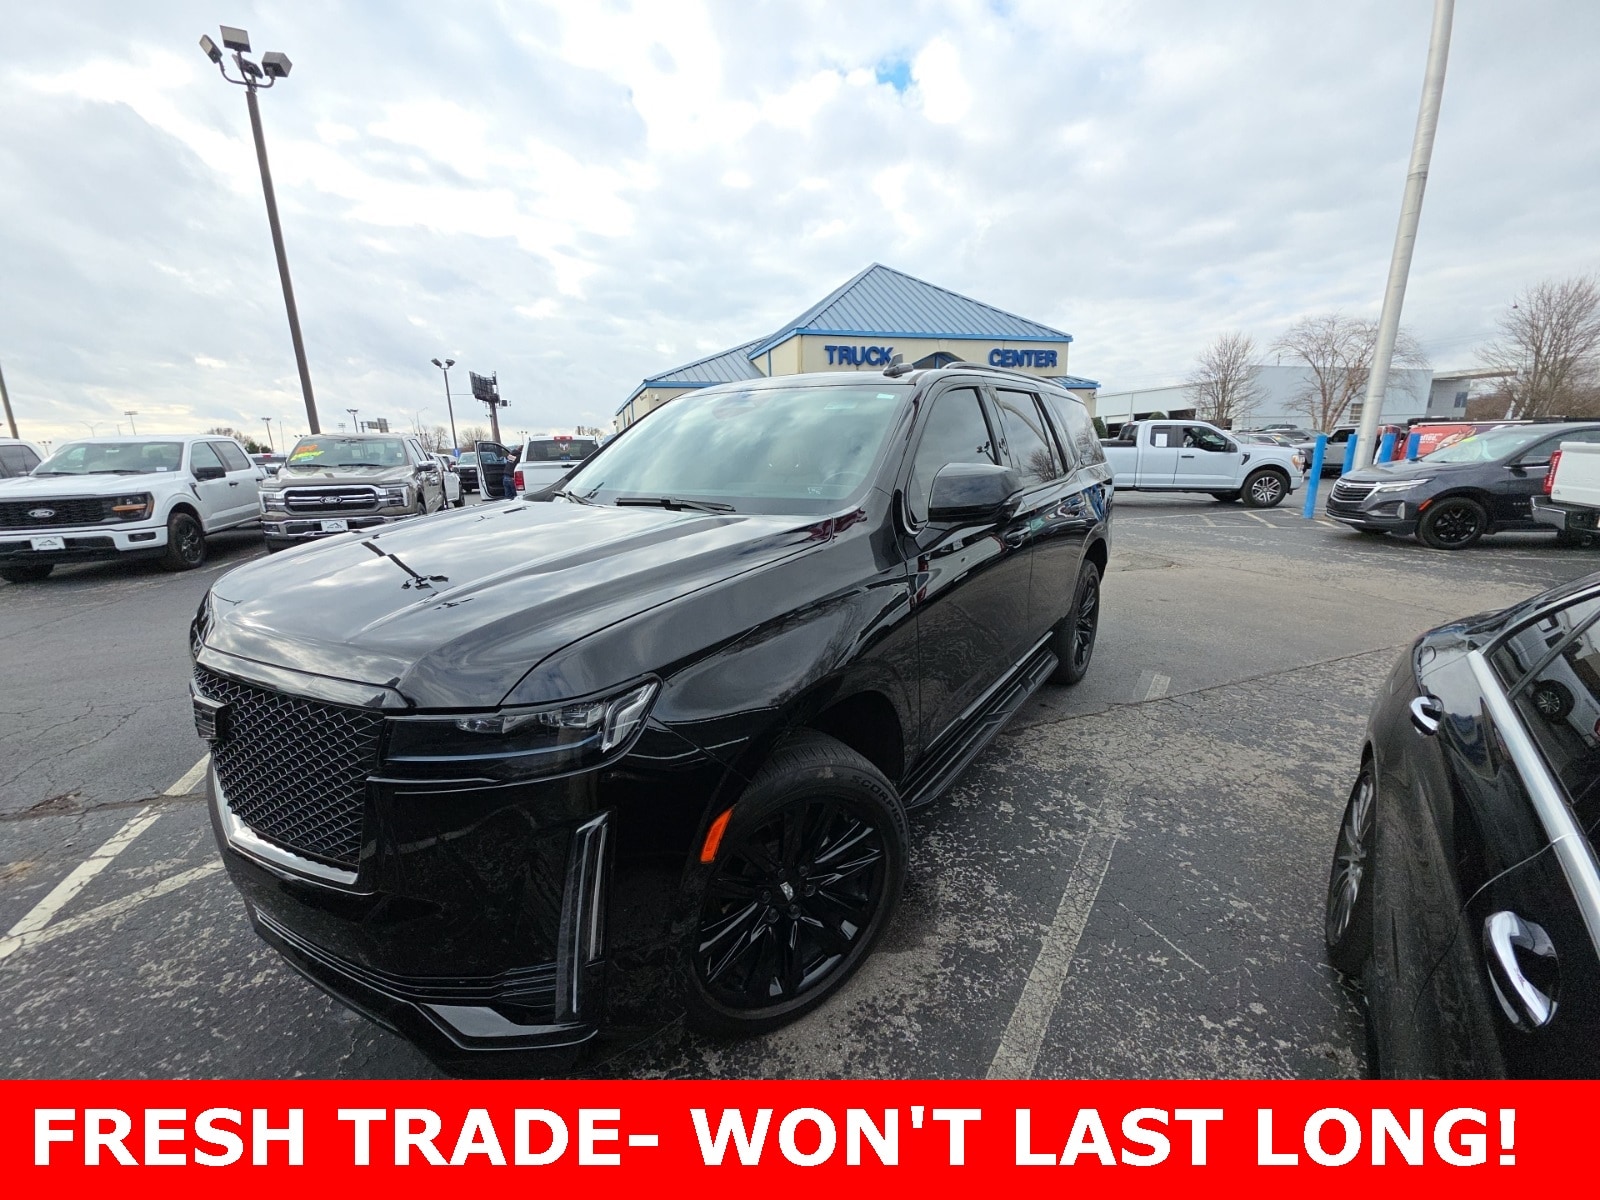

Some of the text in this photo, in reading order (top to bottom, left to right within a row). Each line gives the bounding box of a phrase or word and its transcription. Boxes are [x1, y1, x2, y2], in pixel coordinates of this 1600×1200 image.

[824, 345, 1058, 368] TRUCK CENTER
[850, 775, 905, 835] SCORPION
